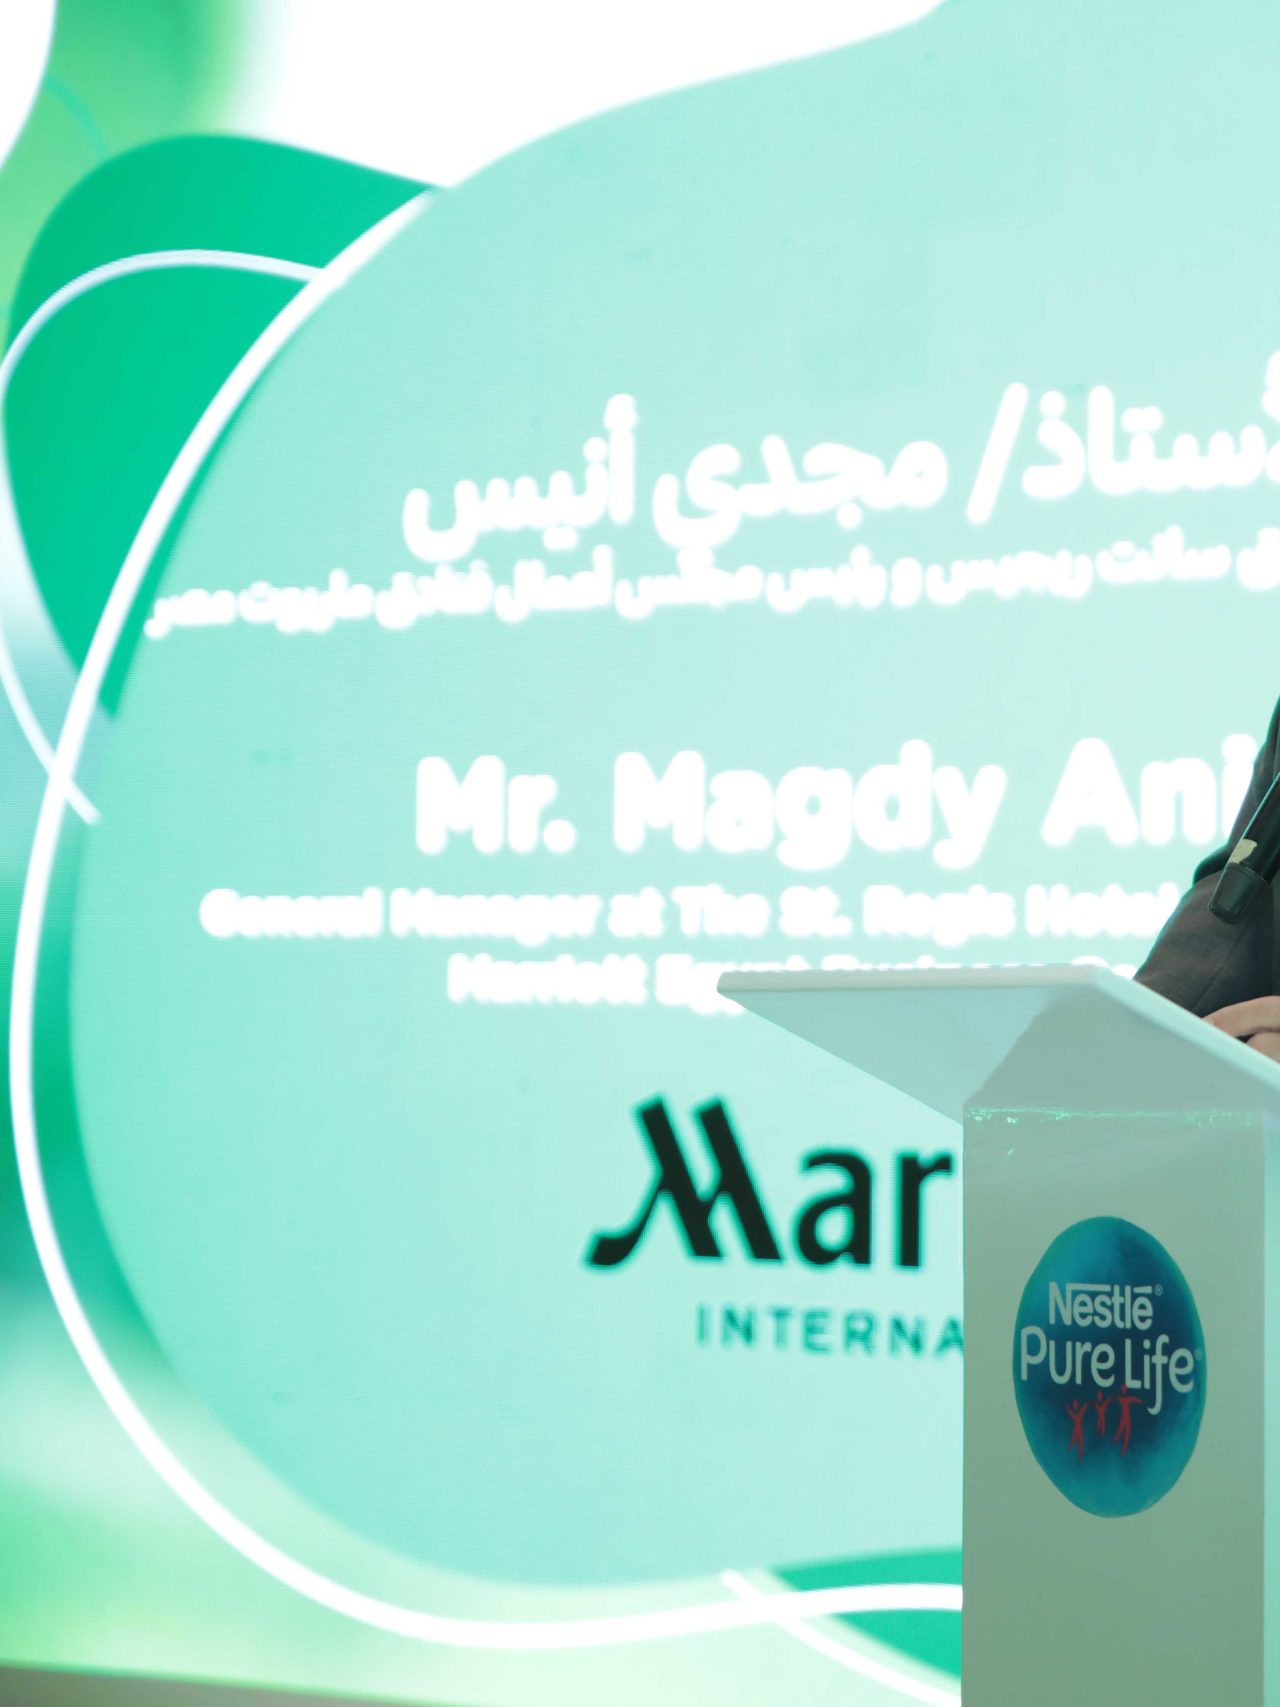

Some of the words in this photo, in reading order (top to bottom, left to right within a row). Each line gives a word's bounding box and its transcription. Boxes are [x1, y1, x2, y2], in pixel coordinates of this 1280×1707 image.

[401, 392, 638, 562] أنيس
[415, 754, 577, 854] Mr.
[612, 738, 1008, 872] Magdy
[199, 887, 384, 938] General
[389, 886, 603, 947] Manager
[607, 886, 667, 938] at
[670, 883, 772, 938] The
[1020, 1325, 1116, 1388] Pure
[1124, 1333, 1195, 1415] Life
